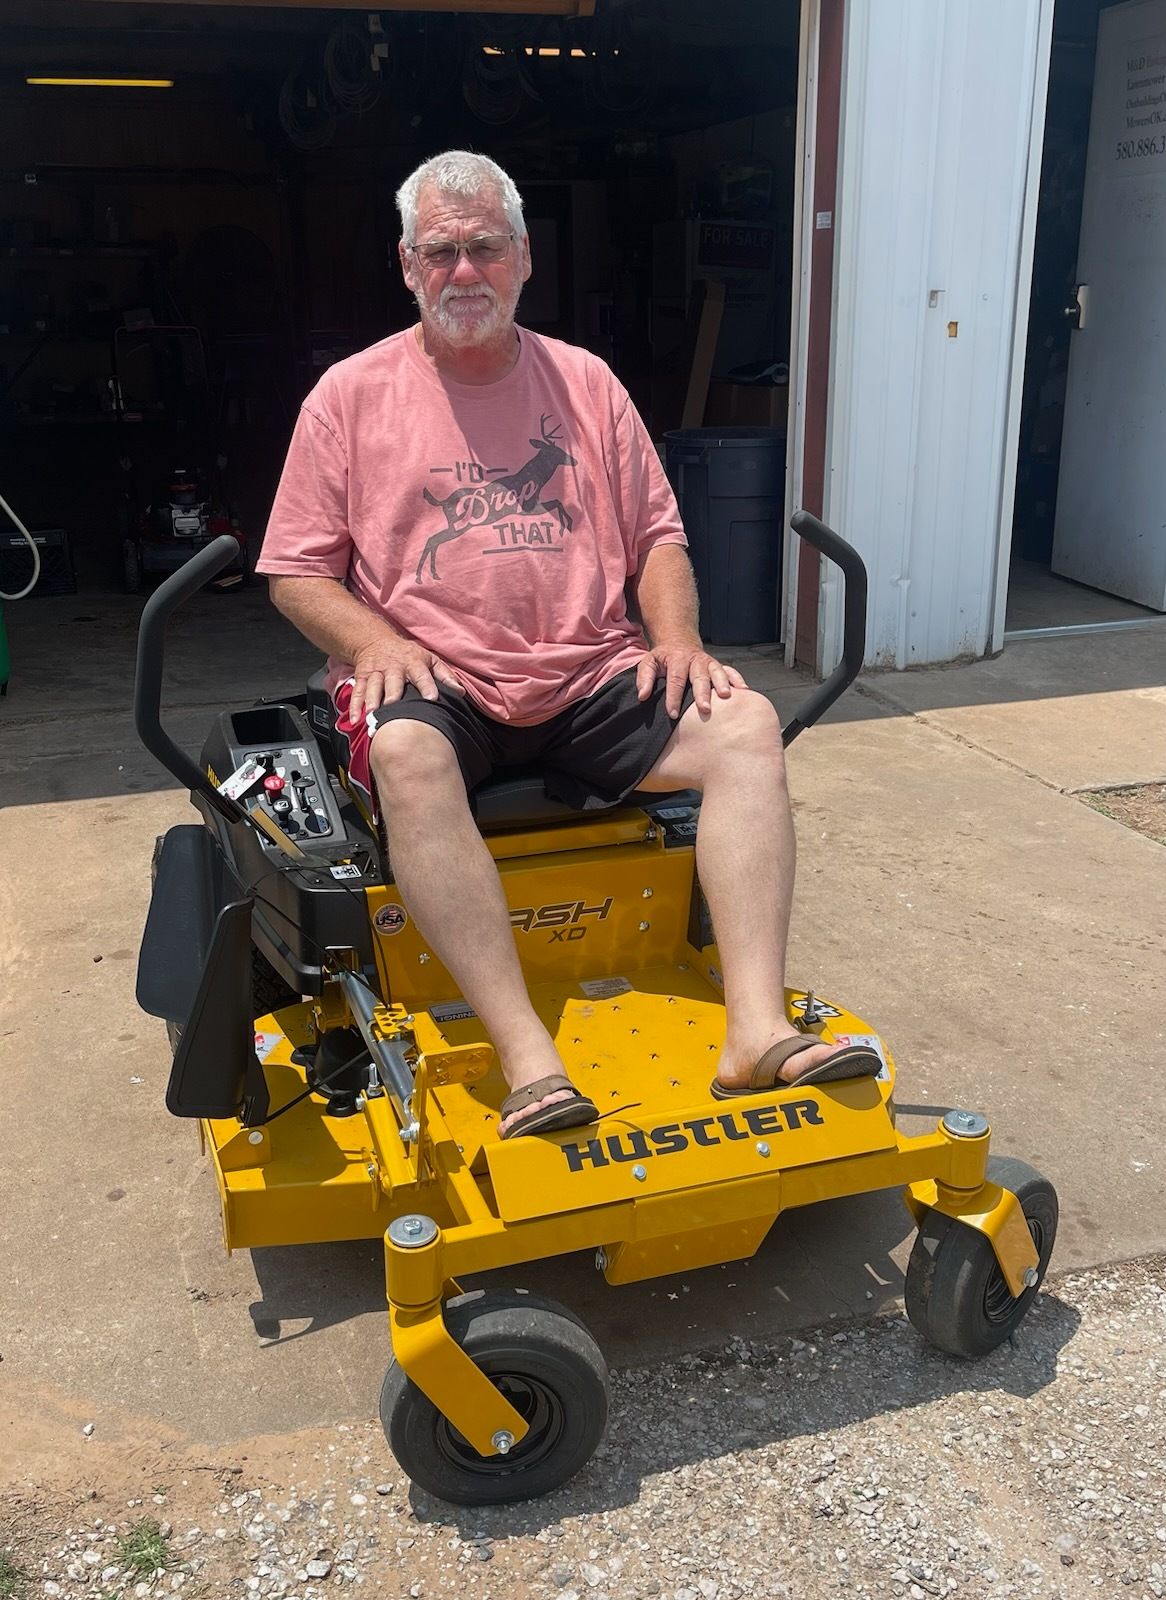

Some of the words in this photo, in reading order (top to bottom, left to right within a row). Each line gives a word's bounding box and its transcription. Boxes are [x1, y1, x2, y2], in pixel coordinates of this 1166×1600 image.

[1115, 136, 1166, 160] 580.886.3
[704, 228, 732, 244] FOR
[735, 230, 769, 249] SALE
[455, 461, 485, 483] I'D
[453, 480, 538, 531] Drop
[493, 521, 554, 545] THAT
[376, 911, 405, 925] USA
[509, 897, 614, 933] ASH
[548, 926, 586, 944] XD
[561, 1099, 825, 1173] HUSTLER
